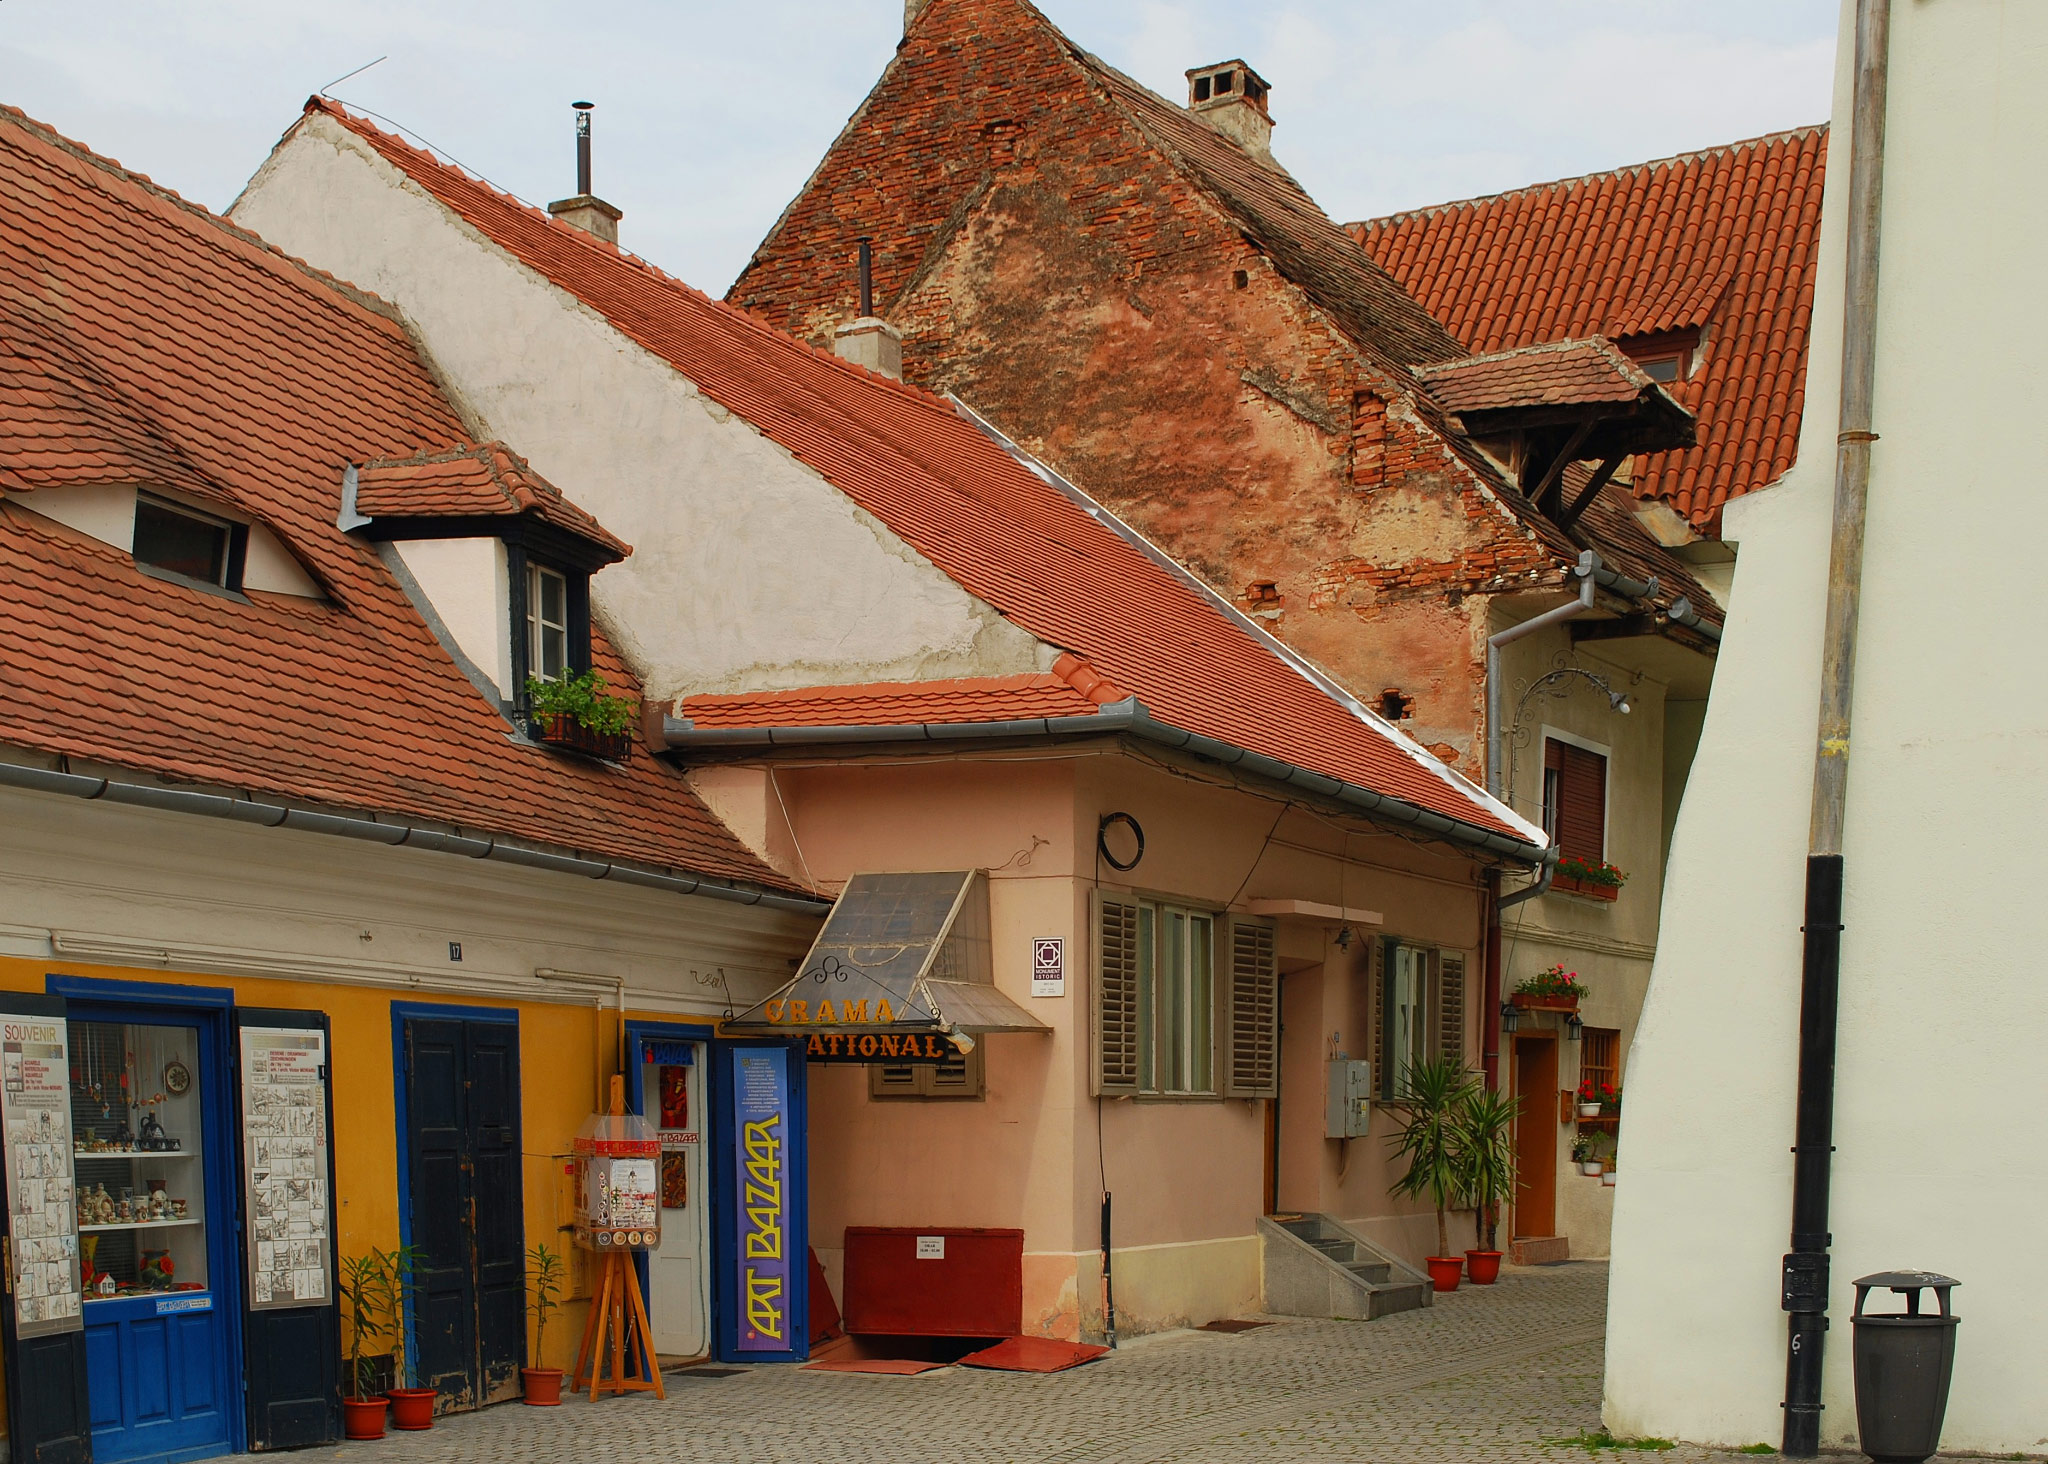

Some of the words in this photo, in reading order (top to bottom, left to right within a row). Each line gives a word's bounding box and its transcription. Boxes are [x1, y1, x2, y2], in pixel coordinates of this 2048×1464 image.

[4, 1024, 57, 1042] SOUVENIR
[785, 1033, 944, 1058] ATIONAL
[315, 1085, 324, 1146] SOUVENIR
[667, 1132, 698, 1142] BAZAAR
[745, 1114, 781, 1259] BAZAAR
[746, 1268, 781, 1340] ART
